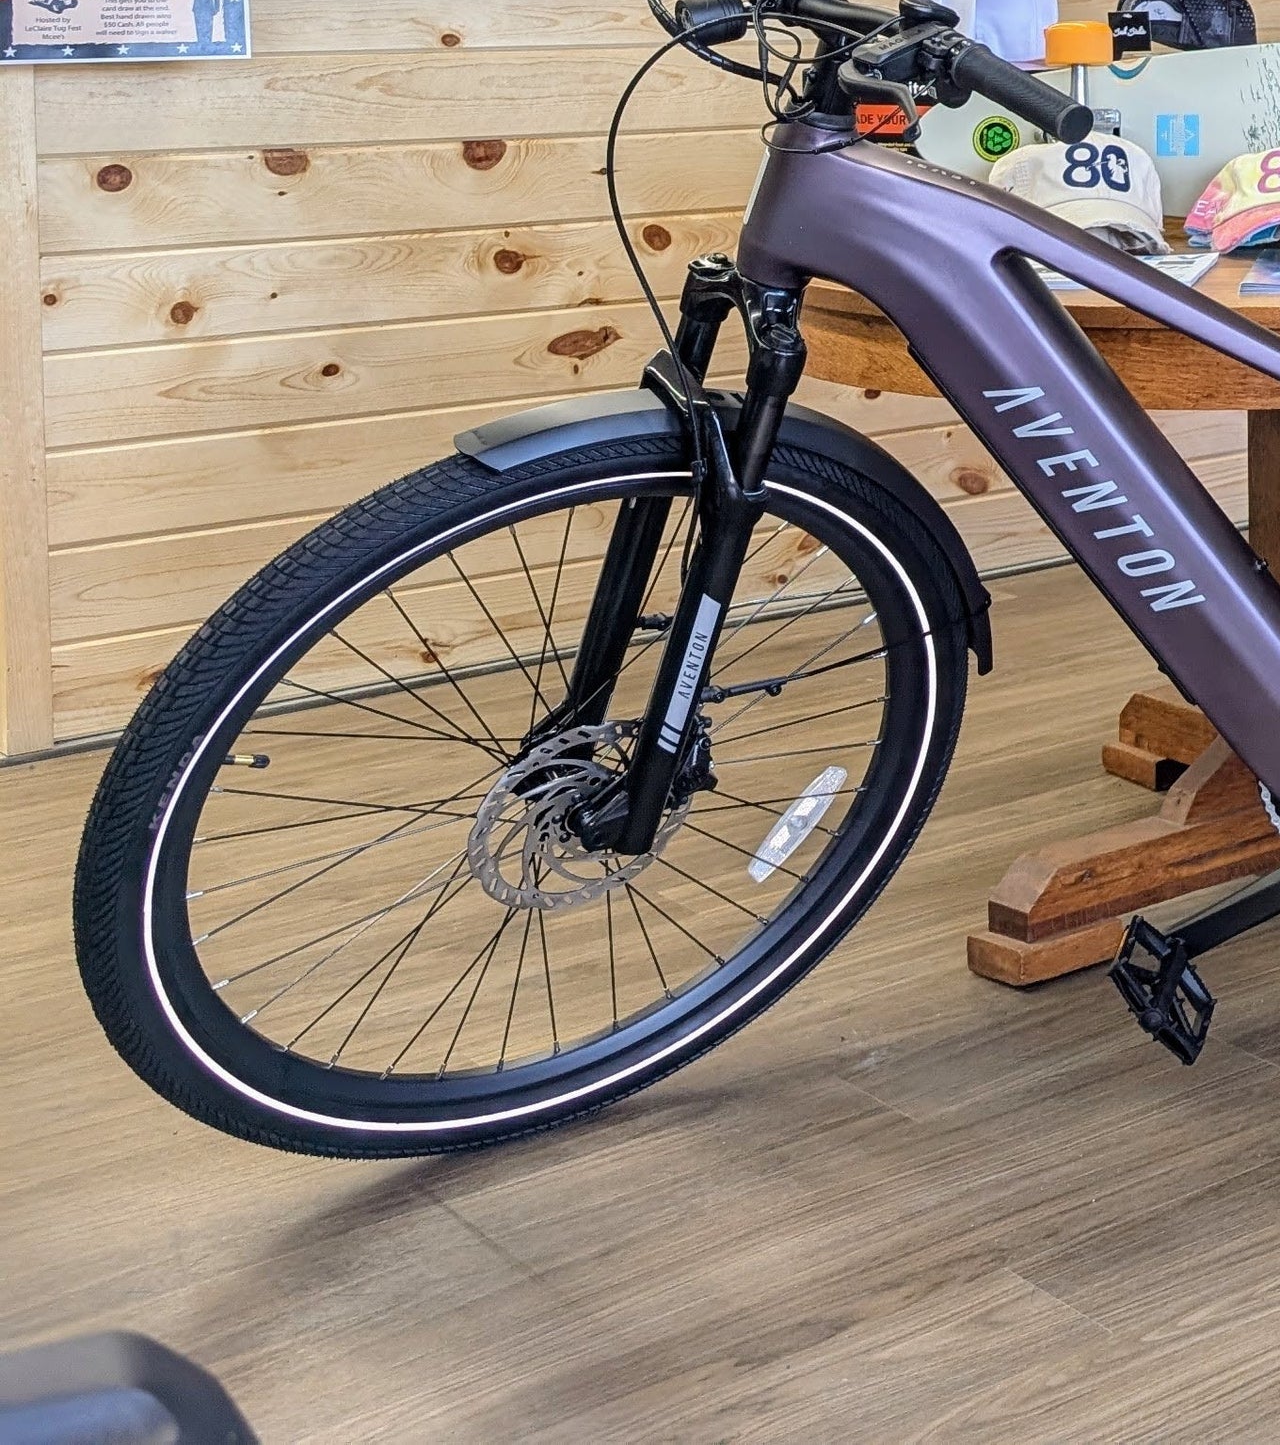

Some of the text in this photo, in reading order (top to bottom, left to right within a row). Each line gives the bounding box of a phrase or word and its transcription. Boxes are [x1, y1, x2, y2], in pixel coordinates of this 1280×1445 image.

[1063, 142, 1131, 192] 80
[982, 387, 1206, 612] AVENTON
[678, 632, 708, 699] AVENTON
